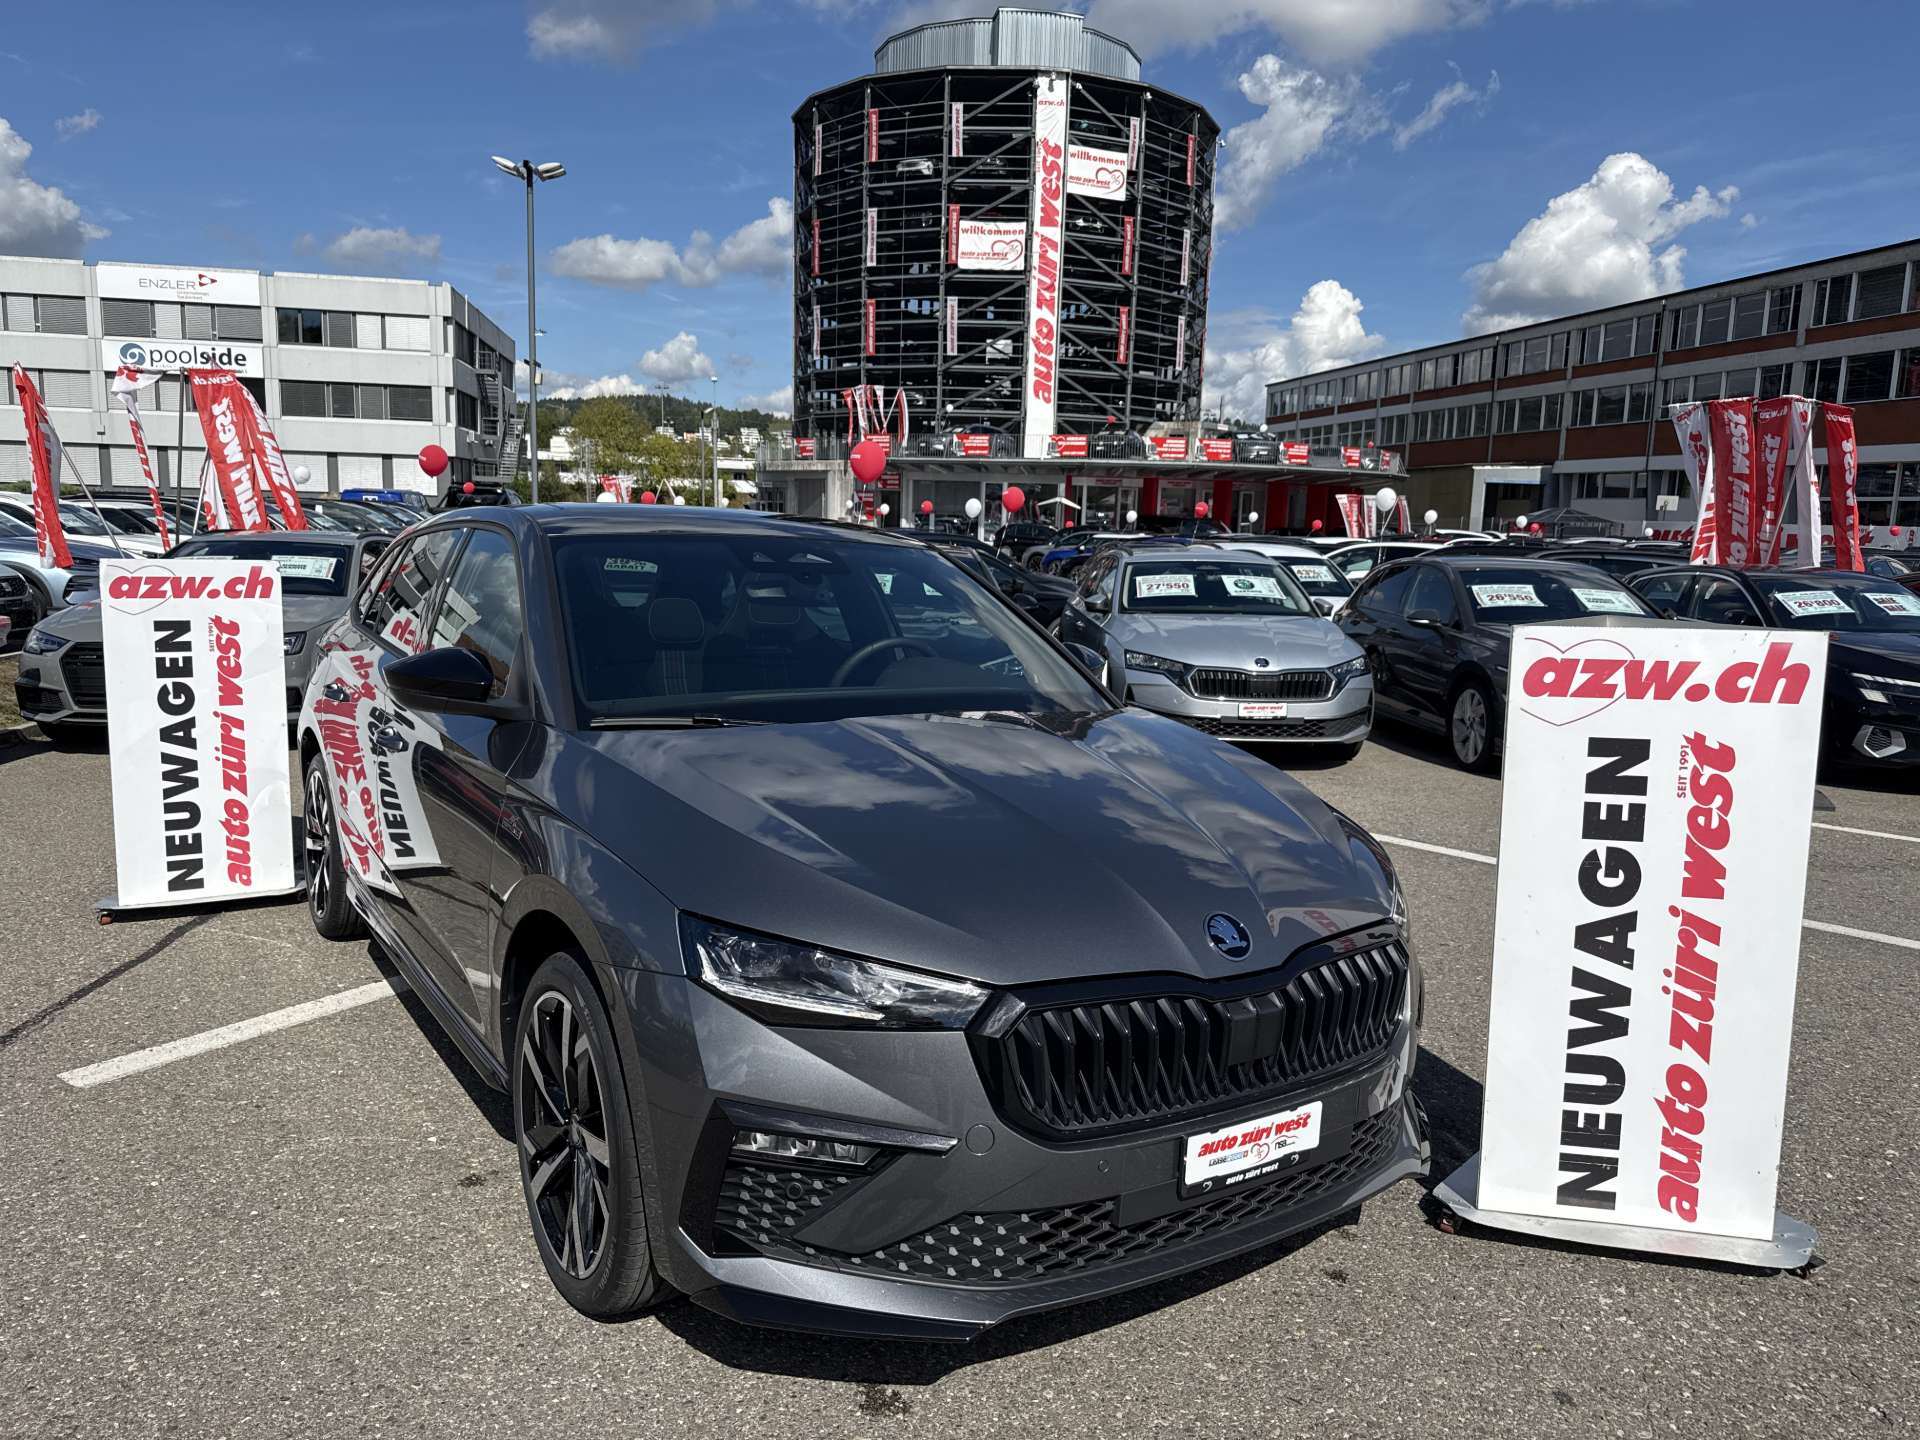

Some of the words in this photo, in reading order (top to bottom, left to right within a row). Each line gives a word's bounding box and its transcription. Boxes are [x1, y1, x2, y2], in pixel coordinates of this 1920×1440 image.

[1040, 137, 1063, 228] west
[1070, 150, 1126, 166] willkommen
[960, 225, 1025, 236] willkommen
[138, 277, 196, 290] ENZLER
[1032, 231, 1059, 318] züri
[150, 346, 247, 368] poolside
[1031, 318, 1055, 405] auto
[1726, 409, 1750, 475] west
[1727, 475, 1750, 540] züri
[108, 566, 275, 600] azw.ch
[1146, 582, 1190, 592] 27'550
[1487, 594, 1534, 602] 26'550
[1794, 599, 1841, 609] 26'800
[208, 614, 243, 706] west
[1522, 642, 1811, 705] azw.ch
[153, 620, 205, 892] NEUWAGEN
[213, 711, 248, 798] züri
[1676, 774, 1688, 799] SEIT
[1679, 744, 1690, 771] 1991
[218, 798, 252, 887] auto
[1681, 731, 1736, 900] west
[1556, 737, 1651, 1211] NEUWAGEN
[1661, 905, 1722, 1065] züri
[1198, 1134, 1239, 1158] auto
[1238, 1122, 1274, 1147] züri
[1274, 1114, 1312, 1136] west
[1652, 1063, 1708, 1223] auto
[1225, 1176, 1244, 1185] auto
[1244, 1169, 1262, 1180] züri
[1262, 1162, 1279, 1173] west
